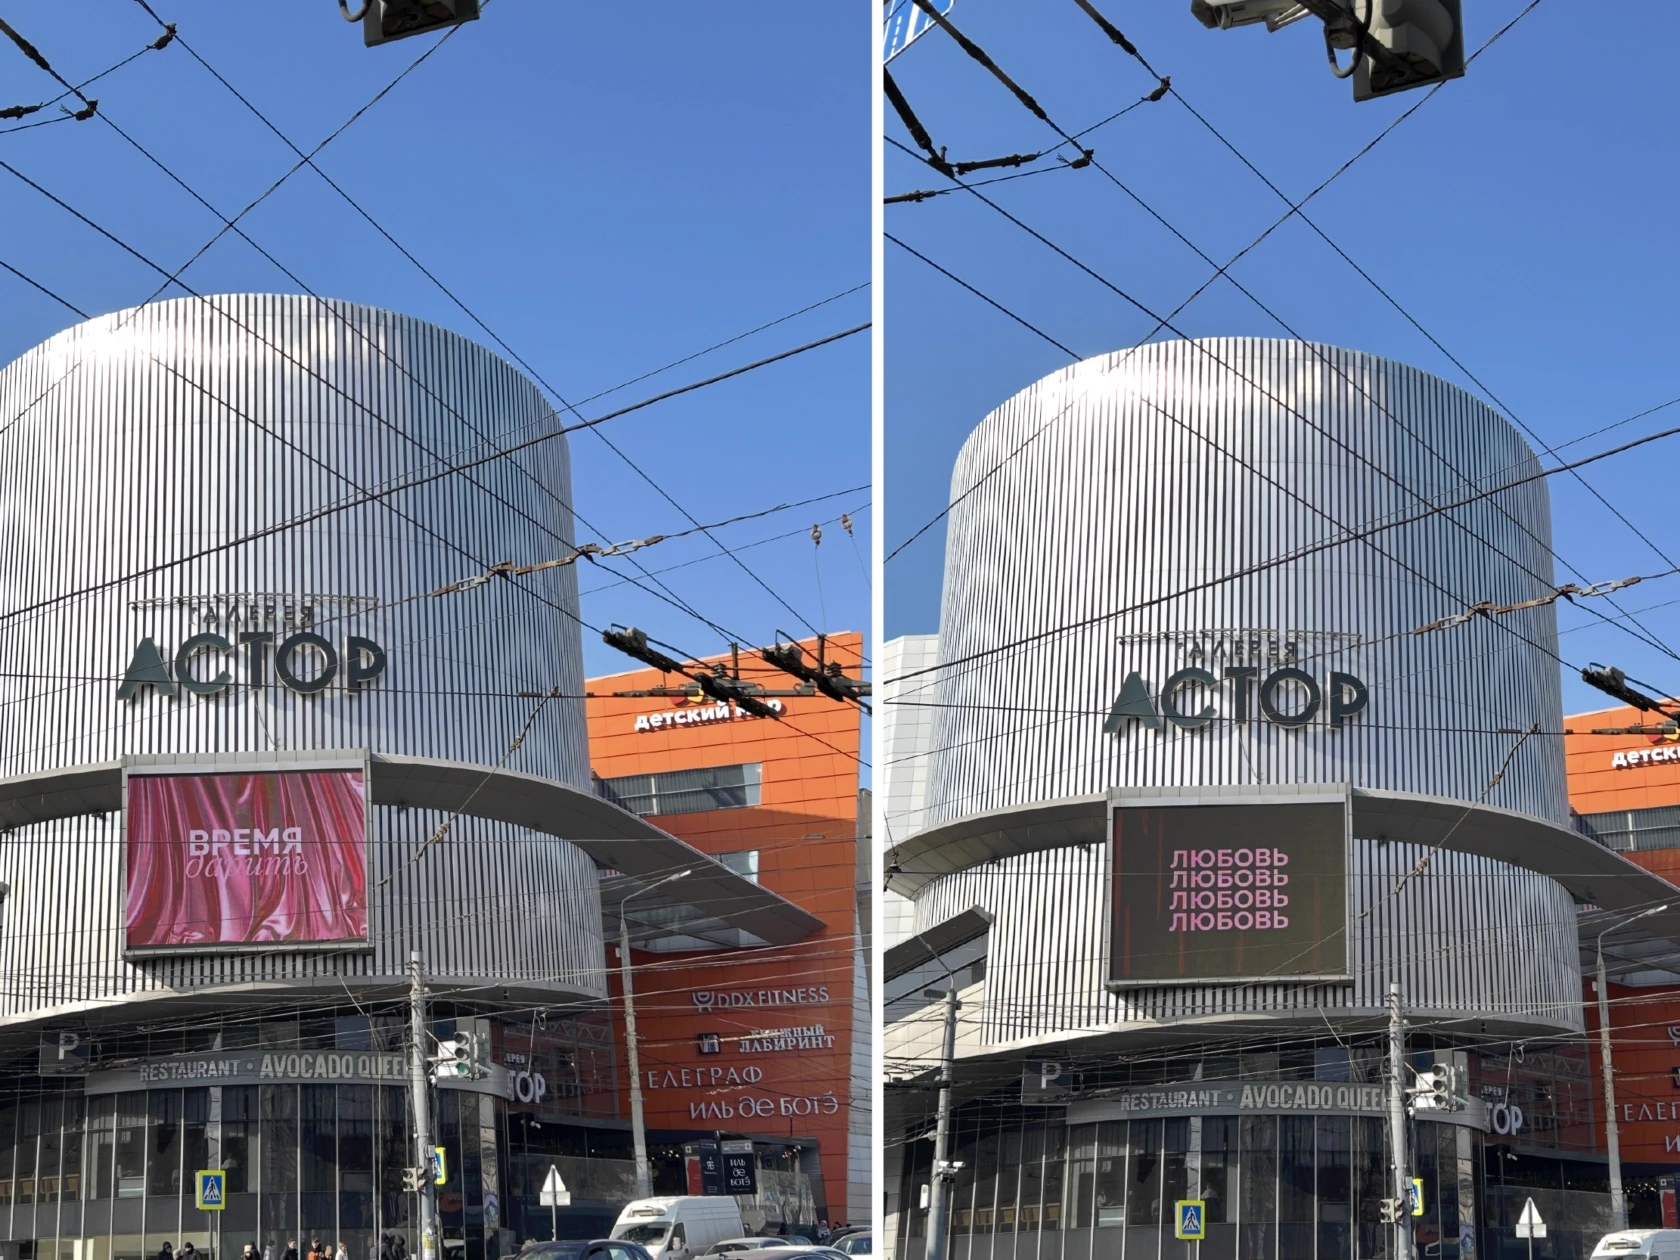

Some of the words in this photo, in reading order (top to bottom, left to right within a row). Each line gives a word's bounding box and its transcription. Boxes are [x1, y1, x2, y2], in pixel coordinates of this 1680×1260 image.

[190, 605, 312, 624] ГАЛЕРЕЯ
[1177, 640, 1297, 659] ГАЛЕРЕЯ
[116, 631, 387, 700] АСТОР
[1102, 666, 1369, 734] АСТОР
[634, 700, 730, 731] детский
[1612, 746, 1680, 768] детск
[189, 827, 302, 857] ВРЕМЯ
[1170, 848, 1289, 869] ЛЮБОВЬ
[1170, 869, 1289, 888] ЛЮБОВЬ
[1169, 889, 1289, 910] ЛЮБОВЬ
[1169, 911, 1289, 932] ЛЮБОВЬ
[718, 992, 754, 1008] DDX
[758, 986, 829, 1006] FITNESS
[58, 1031, 80, 1060] P
[739, 1035, 835, 1054] ЛАБИРИНТ
[139, 1059, 241, 1082] RESTAURANT
[259, 1054, 354, 1080] AVOCADO
[639, 1066, 762, 1088] ЕЛЕГРАФ
[1041, 1062, 1062, 1089] P
[690, 1101, 734, 1120] ИЛЬ
[739, 1096, 775, 1118] де
[1121, 1089, 1222, 1112] RESTAURANT
[1240, 1084, 1333, 1110] AVOCADO
[1615, 1101, 1680, 1122] ЕЛЕГ
[729, 1158, 746, 1167] ИЛЬ
